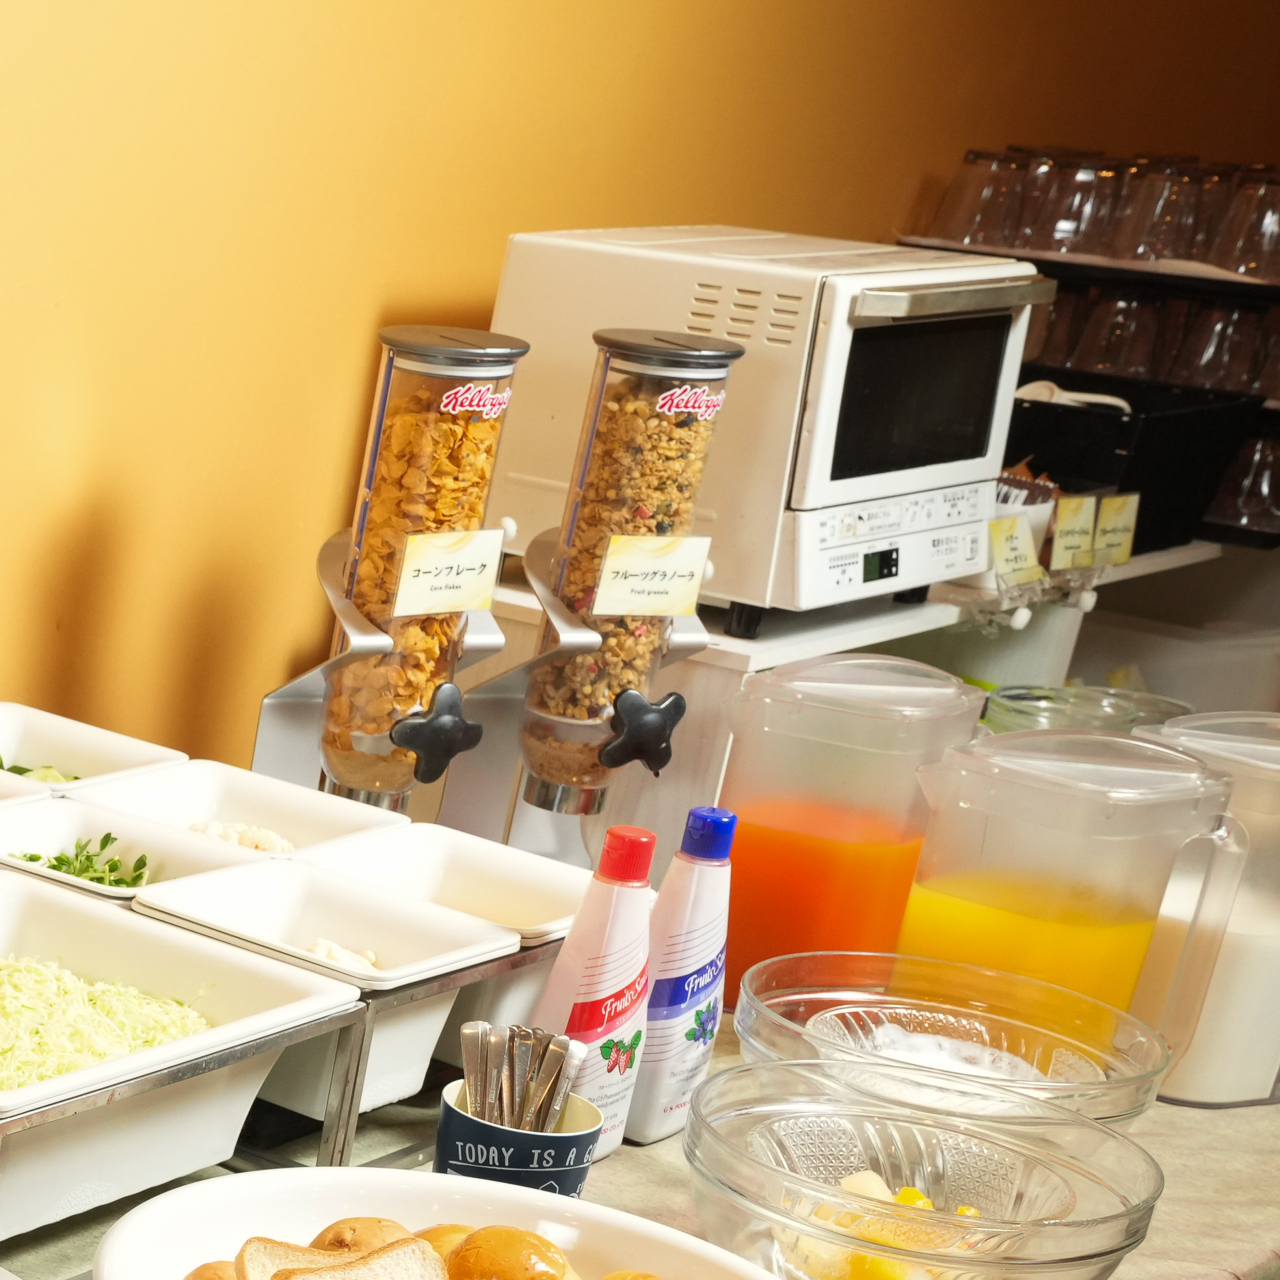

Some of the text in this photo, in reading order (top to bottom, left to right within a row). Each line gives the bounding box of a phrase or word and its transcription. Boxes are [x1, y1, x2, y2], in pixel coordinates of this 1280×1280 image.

[412, 563, 487, 578] コーンフレーク
[612, 570, 694, 581] フルーツグラノーラ
[681, 965, 713, 1008] Fruits
[597, 988, 633, 1033] Fruits
[455, 1141, 514, 1167] TODAY
[529, 1149, 556, 1168] IS
[565, 1147, 577, 1167] A
